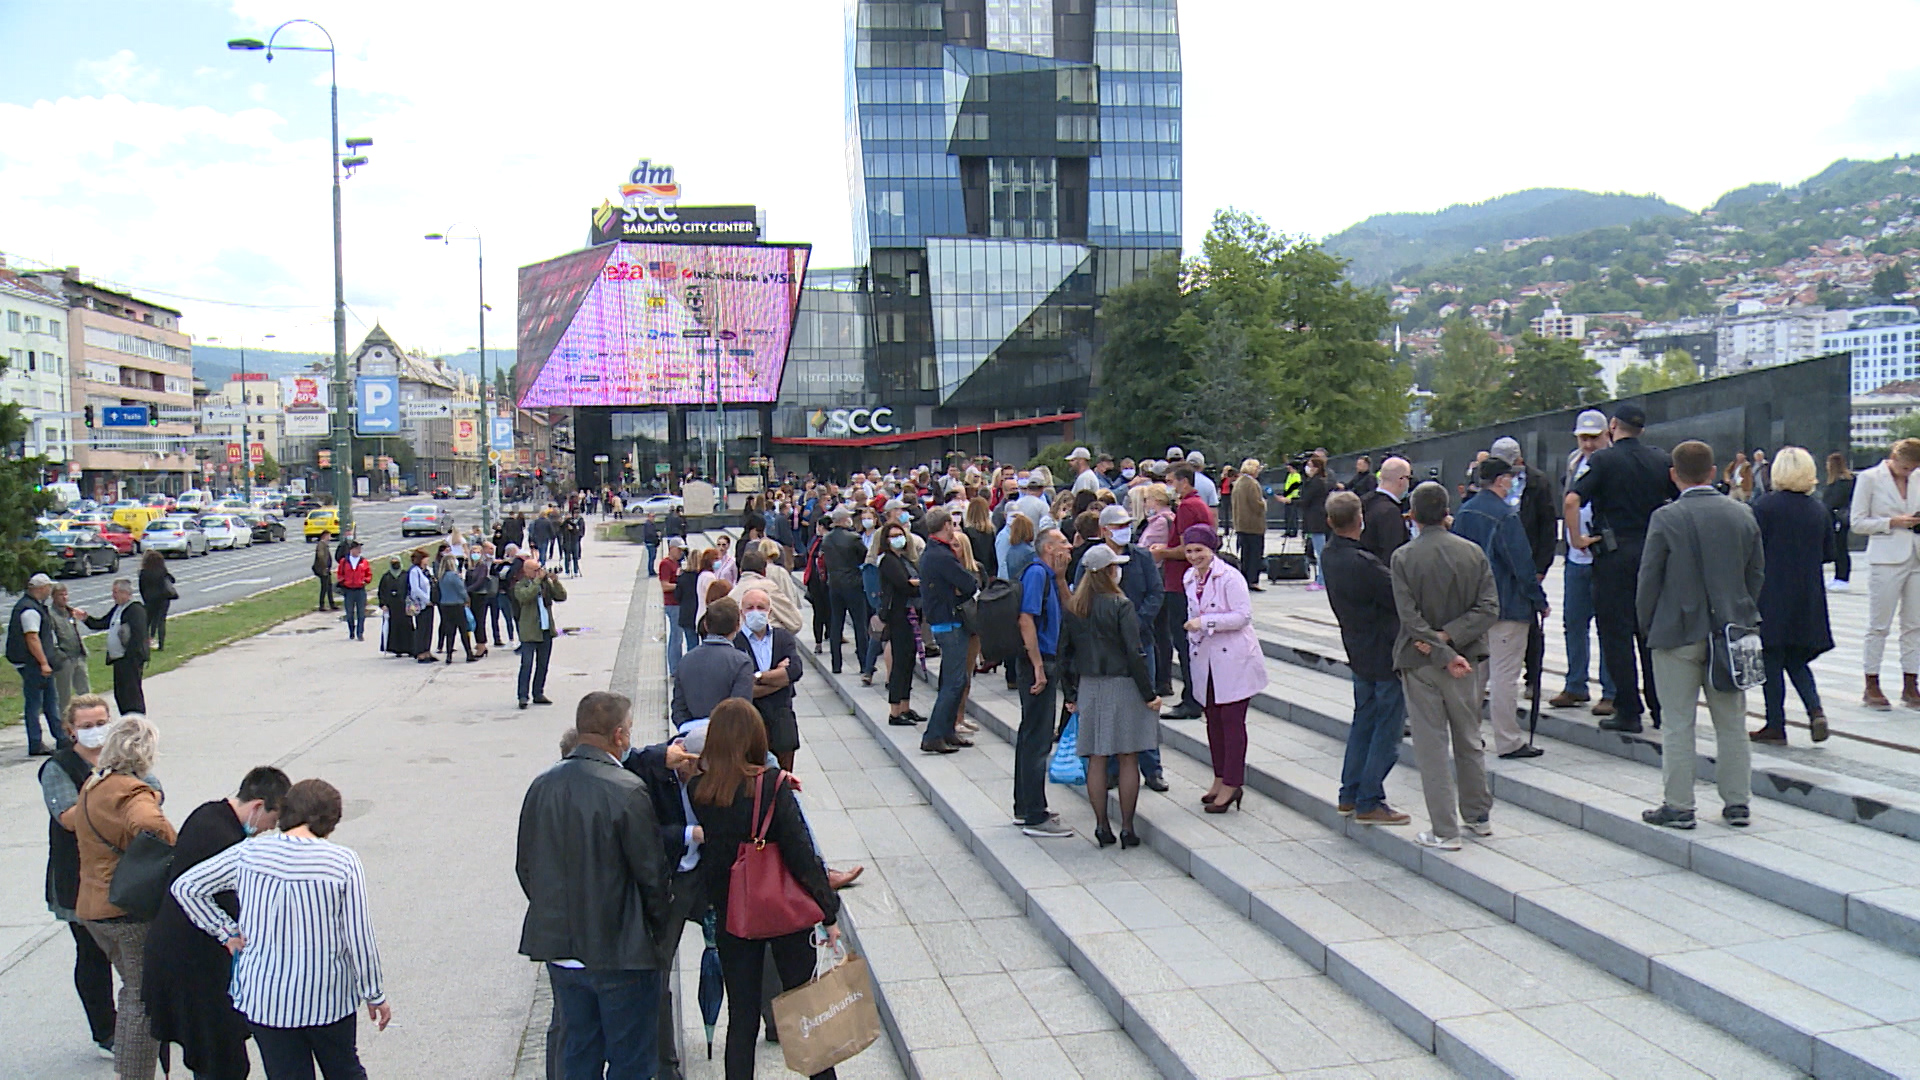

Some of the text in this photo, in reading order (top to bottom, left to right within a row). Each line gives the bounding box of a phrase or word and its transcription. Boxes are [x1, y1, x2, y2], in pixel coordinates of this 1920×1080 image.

[631, 161, 673, 185] dm
[622, 199, 678, 222] SCC
[623, 221, 754, 234] SARAJEVO CITY CENTER
[364, 383, 392, 415] P
[495, 423, 510, 440] P
[831, 408, 893, 434] SCC
